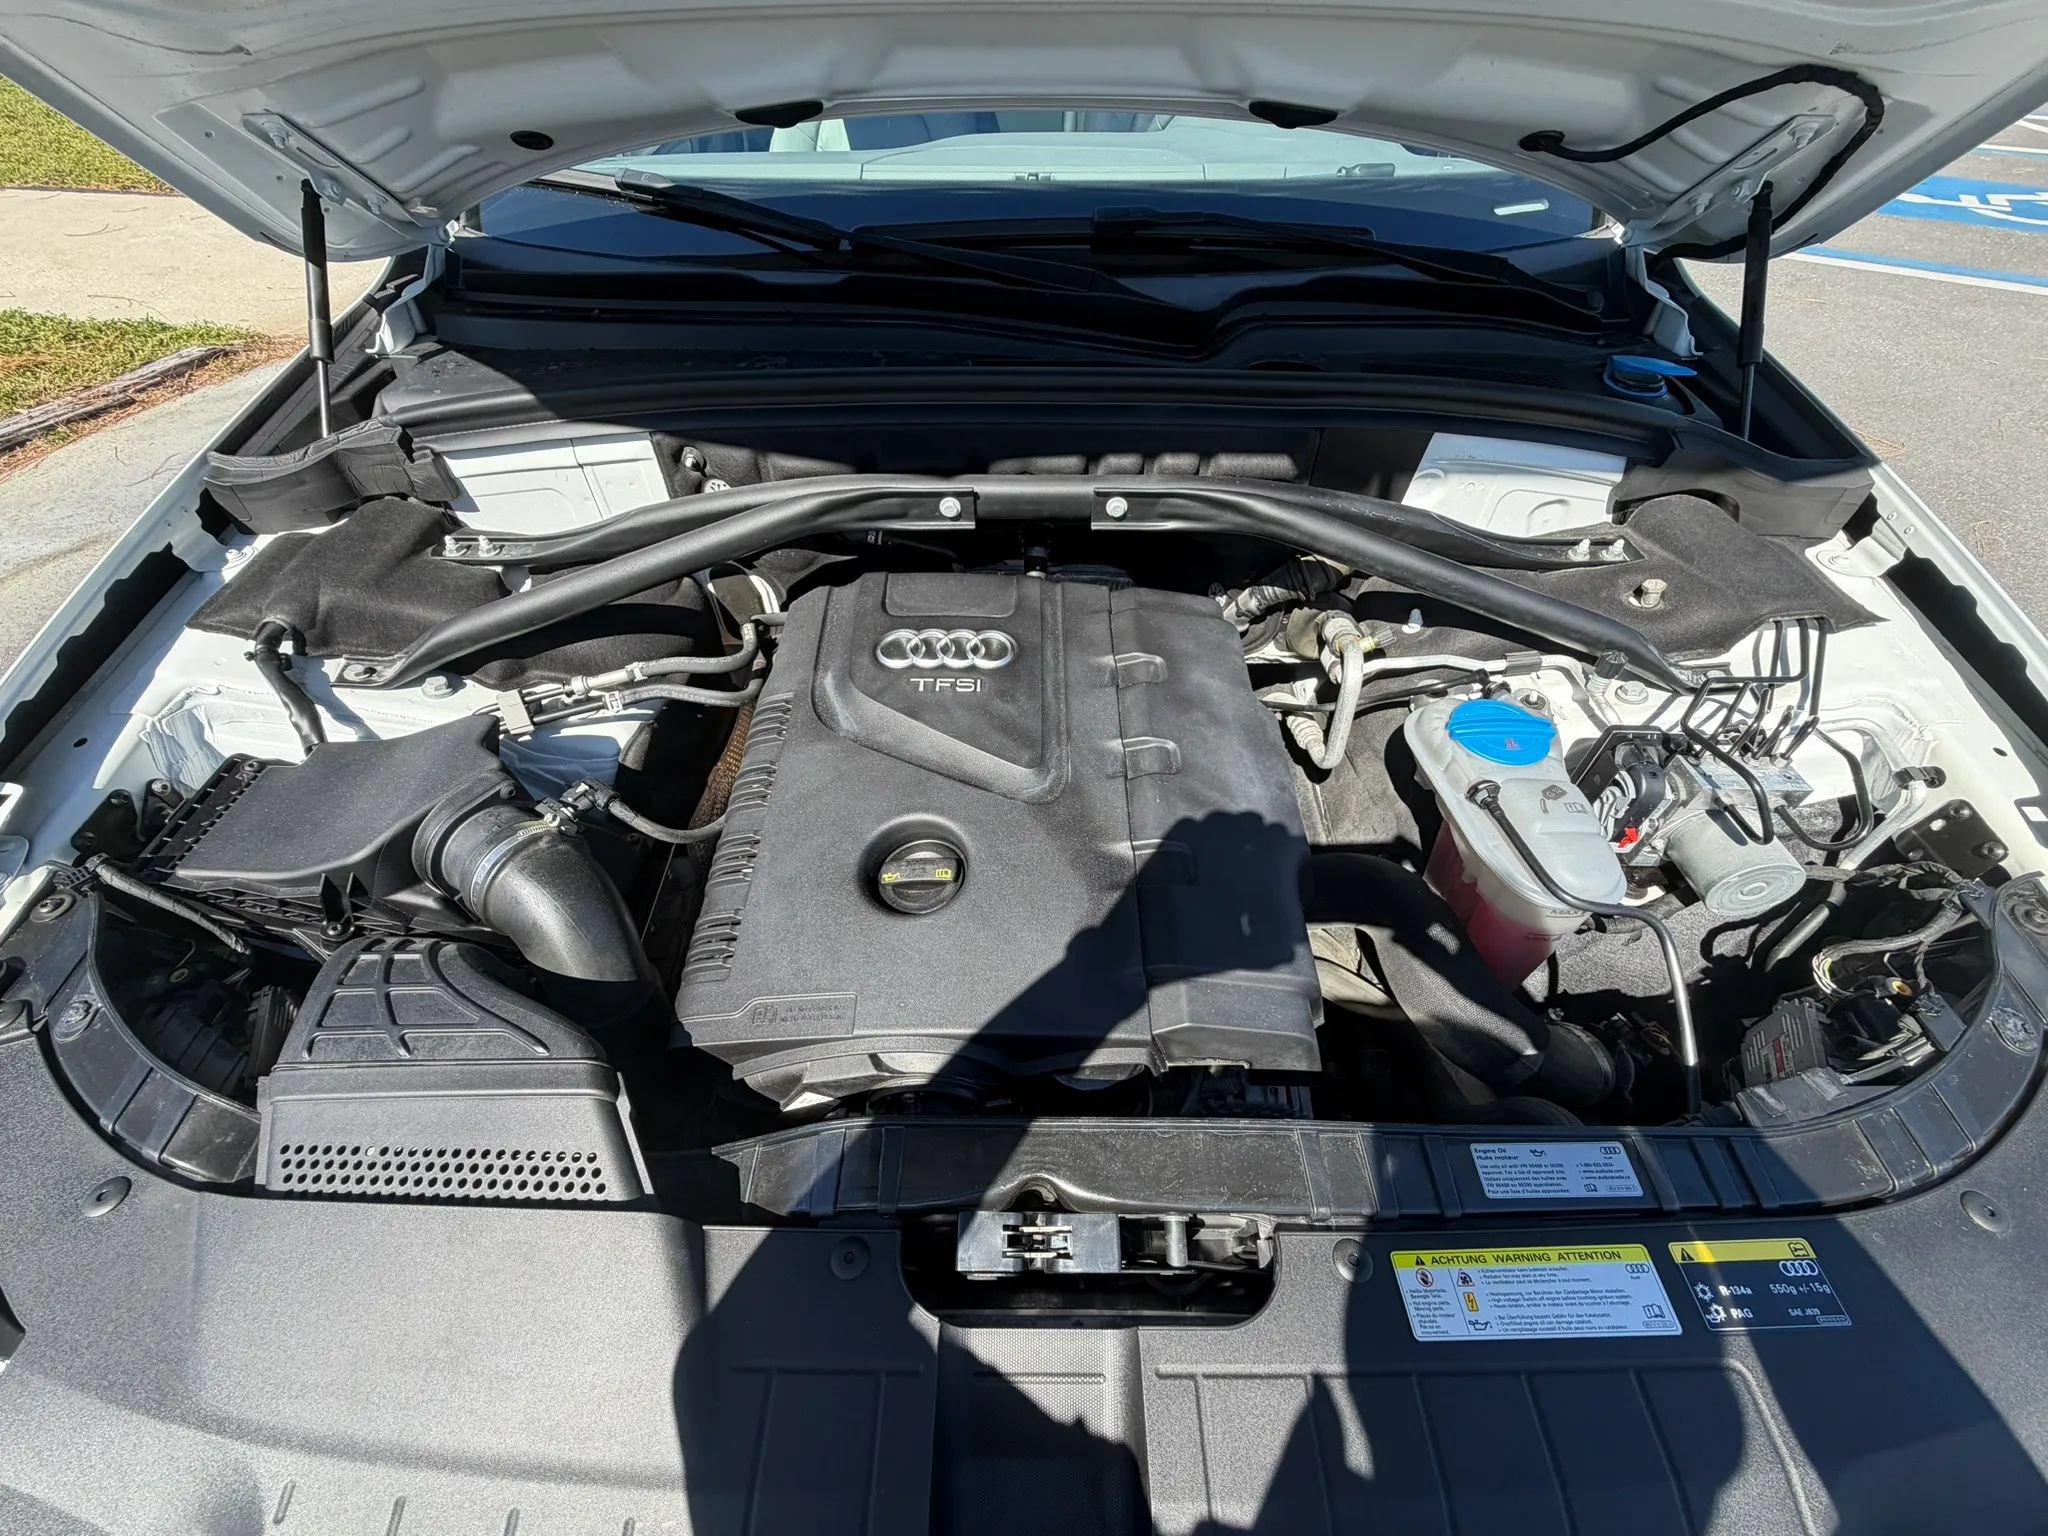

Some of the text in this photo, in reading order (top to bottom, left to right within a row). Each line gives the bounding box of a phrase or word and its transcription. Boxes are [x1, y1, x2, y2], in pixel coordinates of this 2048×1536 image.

[910, 678, 981, 692] TFSI
[1430, 1250, 1622, 1265] ACHTUNG WARNING ATTENTION
[1718, 1285, 1752, 1297] R-134a
[1769, 1283, 1797, 1296] 550g
[1730, 1307, 1754, 1319] PAG
